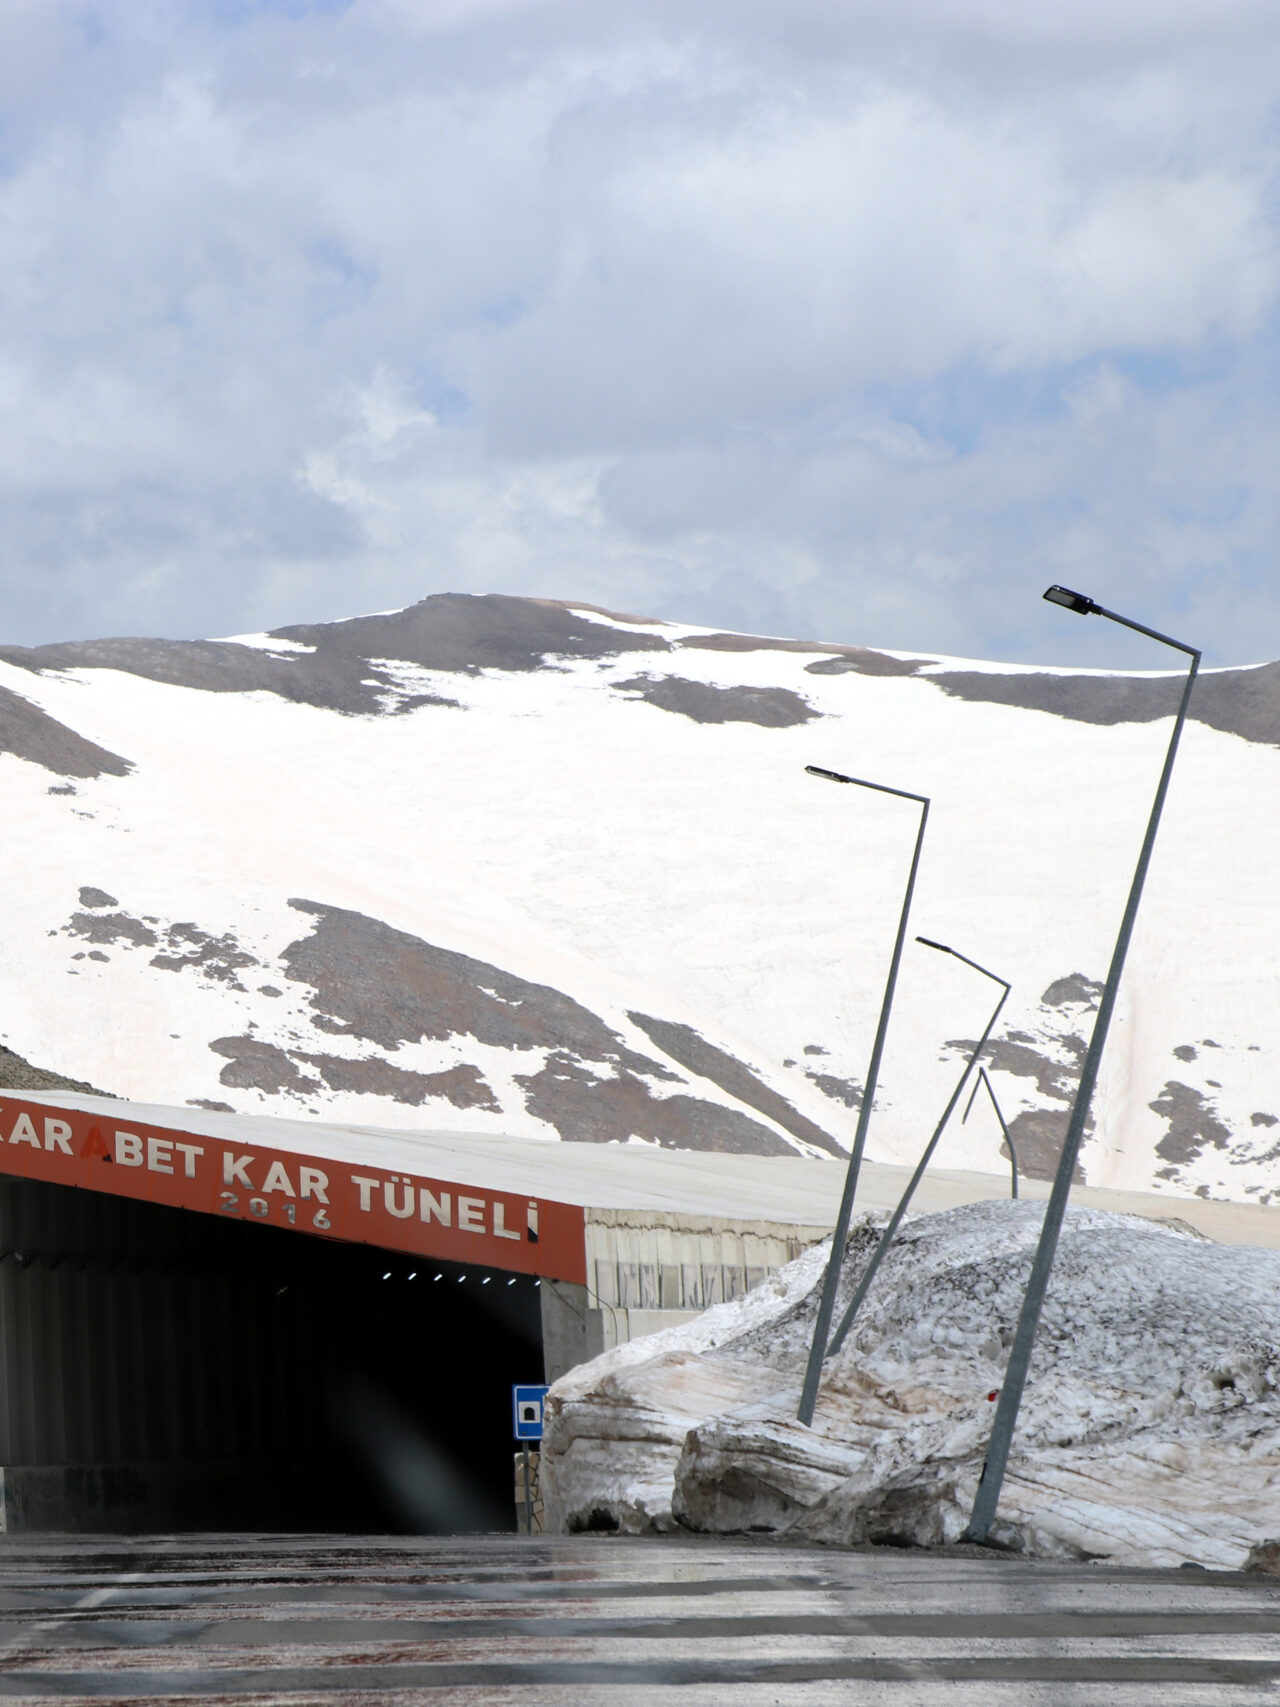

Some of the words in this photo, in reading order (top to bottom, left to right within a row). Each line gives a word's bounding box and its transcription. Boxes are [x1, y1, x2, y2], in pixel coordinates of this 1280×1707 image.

[220, 1191, 332, 1230] 2016
[223, 1151, 331, 1205] KAR
[351, 1174, 540, 1244] TÜNELİ
